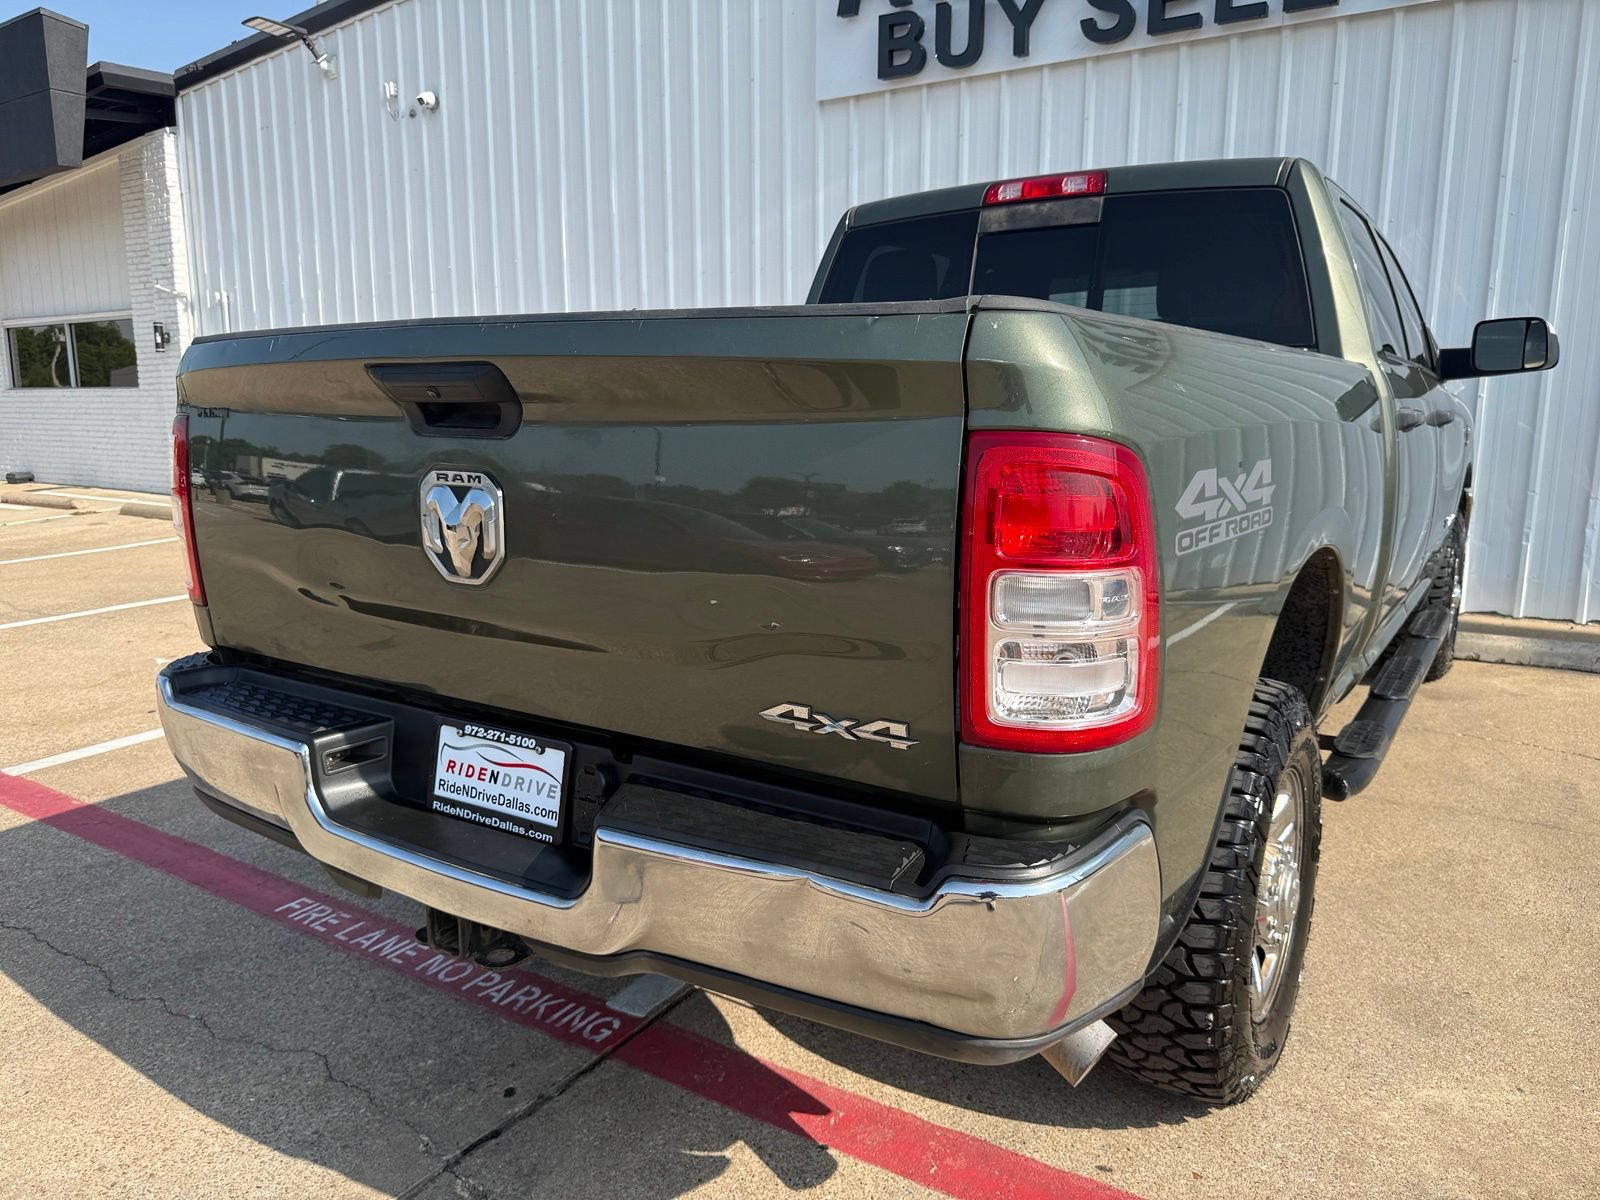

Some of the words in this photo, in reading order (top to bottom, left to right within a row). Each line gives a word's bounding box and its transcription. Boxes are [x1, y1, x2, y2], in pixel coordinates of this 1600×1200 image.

[877, 0, 1043, 80] BUY
[435, 472, 482, 484] RAM
[1177, 524, 1222, 553] OFF
[1225, 508, 1272, 538] ROAD
[464, 724, 536, 749] 972-271-5100
[432, 800, 553, 843] RideNDriveDallas.com
[438, 778, 558, 822] RideNDriveDallas.com
[274, 896, 349, 933] FIRE
[334, 920, 430, 965] LANE
[415, 953, 474, 984] NO
[462, 970, 620, 1044] PARKING
